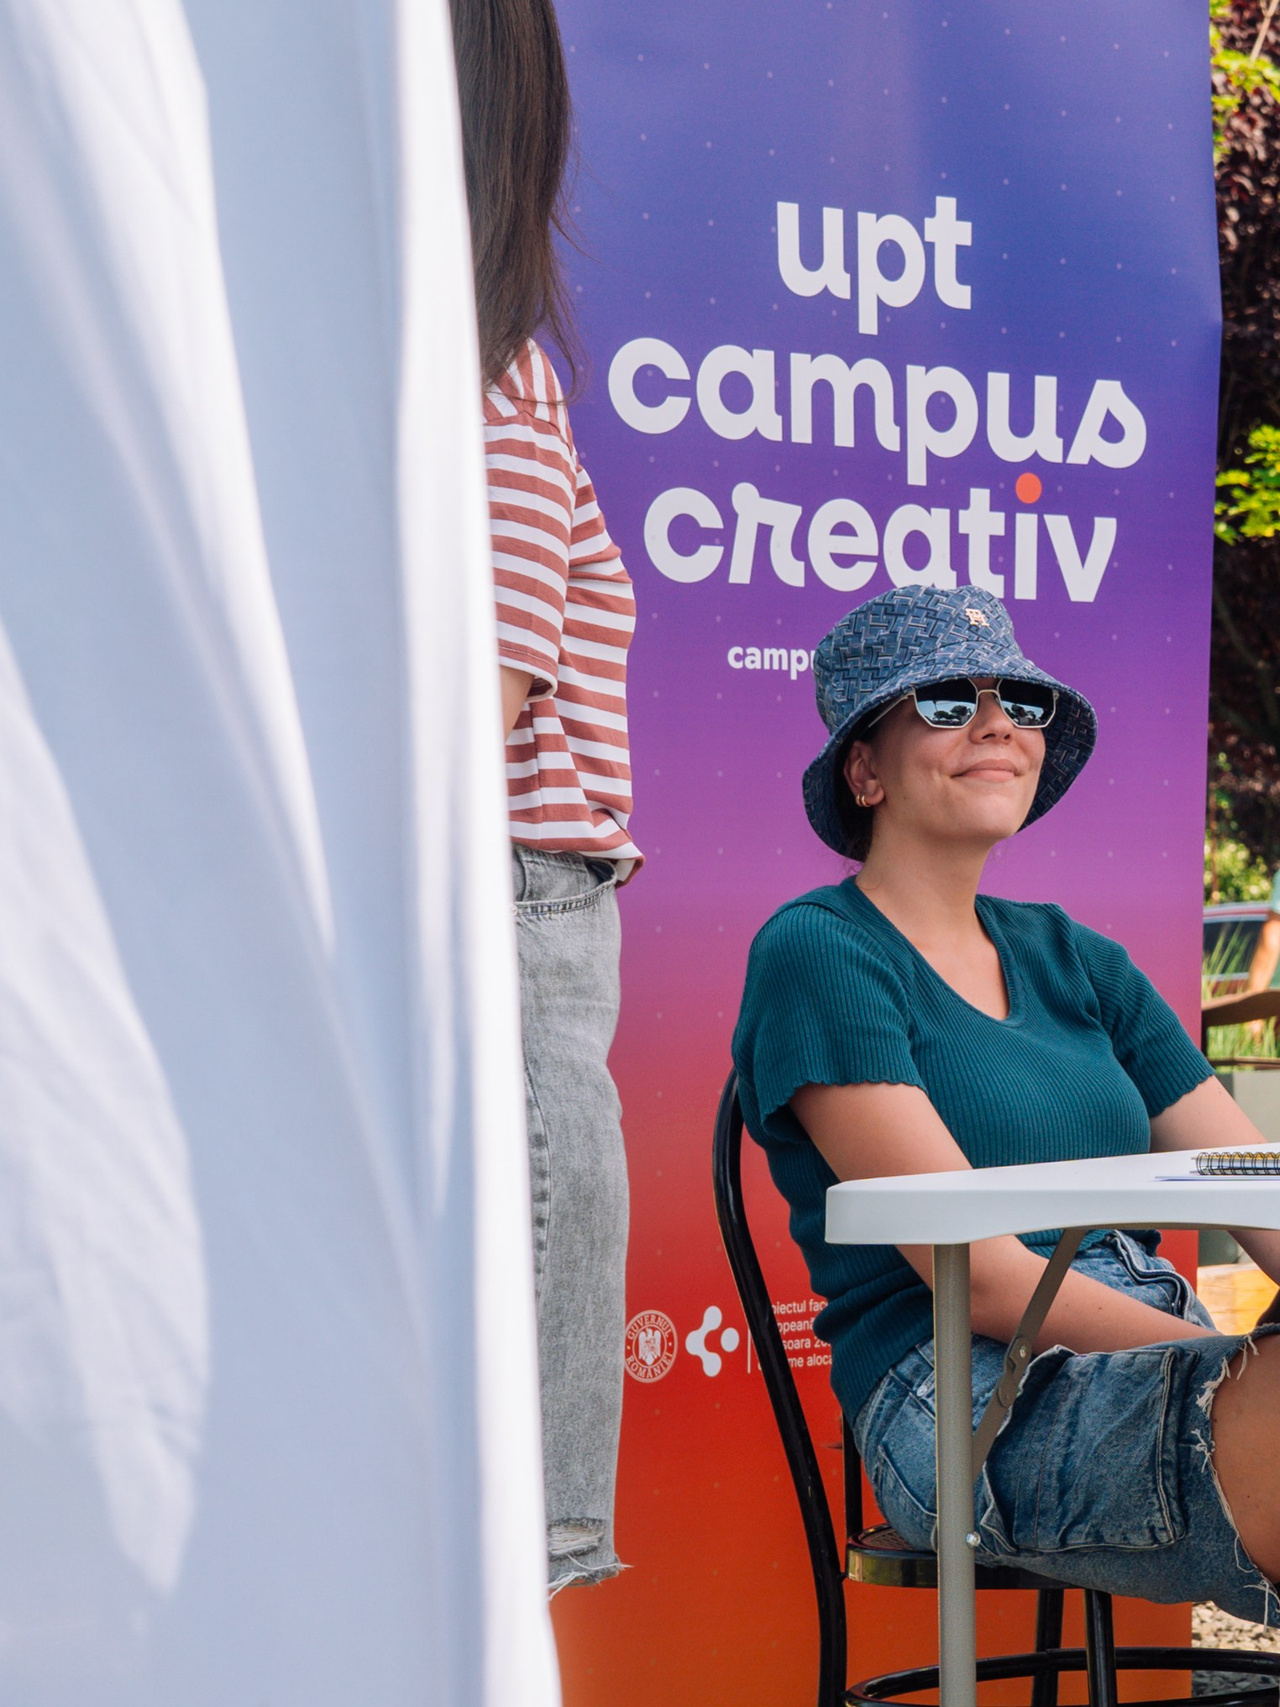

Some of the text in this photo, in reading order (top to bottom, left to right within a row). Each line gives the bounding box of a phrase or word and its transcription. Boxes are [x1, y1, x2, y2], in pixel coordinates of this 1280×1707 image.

[776, 195, 973, 336] upt
[608, 336, 1148, 487] campus
[643, 472, 1118, 604] creativ
[626, 1314, 673, 1341] GUVERNUL
